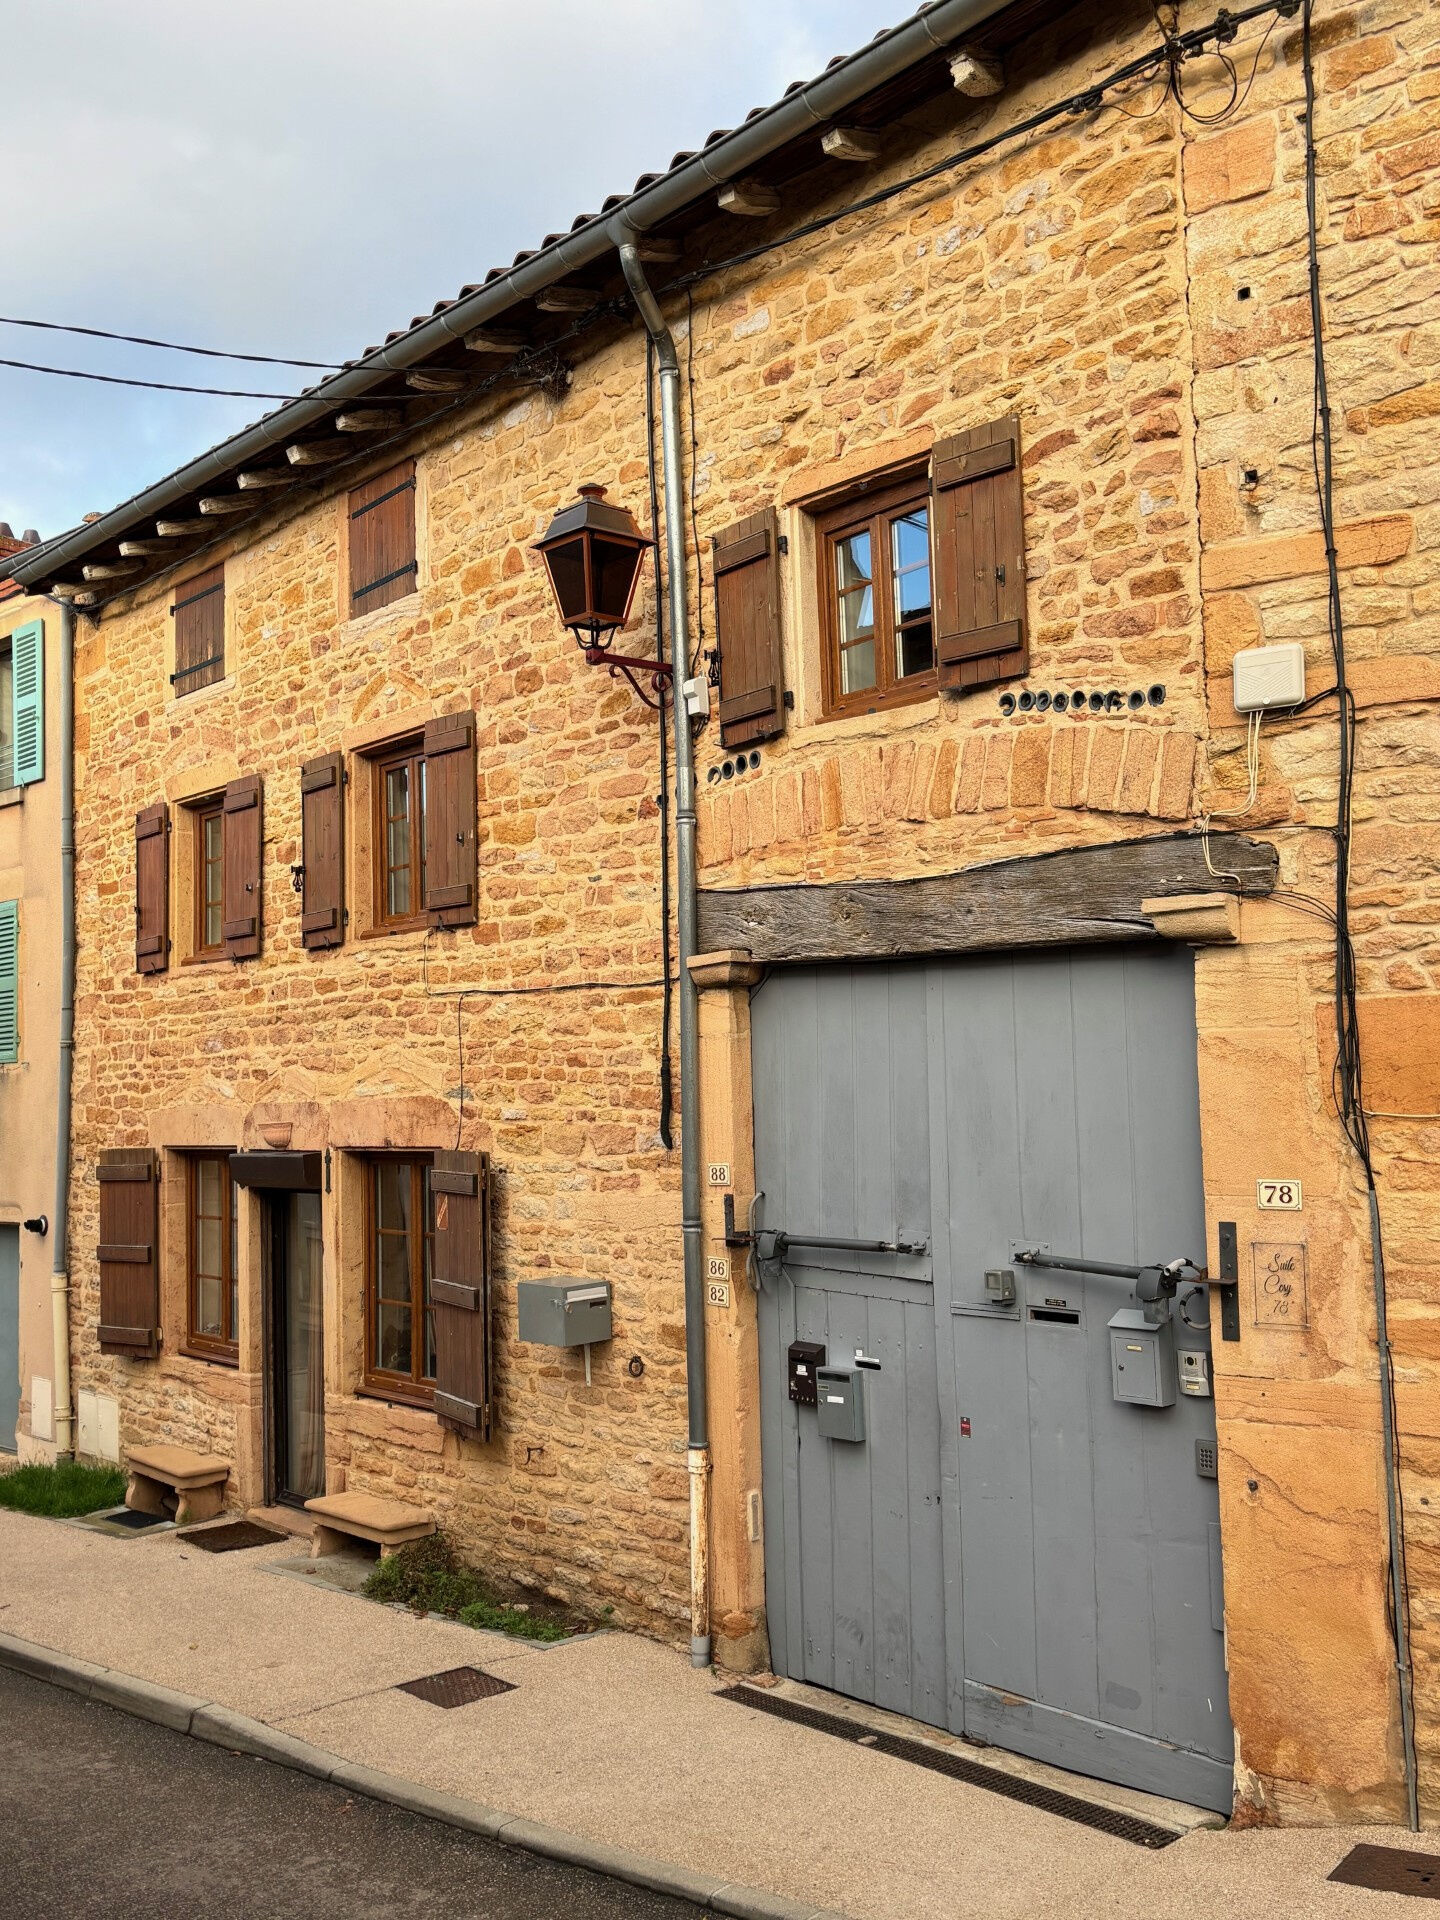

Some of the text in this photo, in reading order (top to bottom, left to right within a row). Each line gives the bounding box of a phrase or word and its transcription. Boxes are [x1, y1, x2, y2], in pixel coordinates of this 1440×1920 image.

[711, 1167, 726, 1181] 88
[1264, 1185, 1293, 1204] 78
[710, 1260, 725, 1275] 86
[1259, 1253, 1296, 1273] Suite
[1264, 1274, 1293, 1297] Cosy
[710, 1287, 725, 1302] 82
[1273, 1299, 1289, 1315] 78
